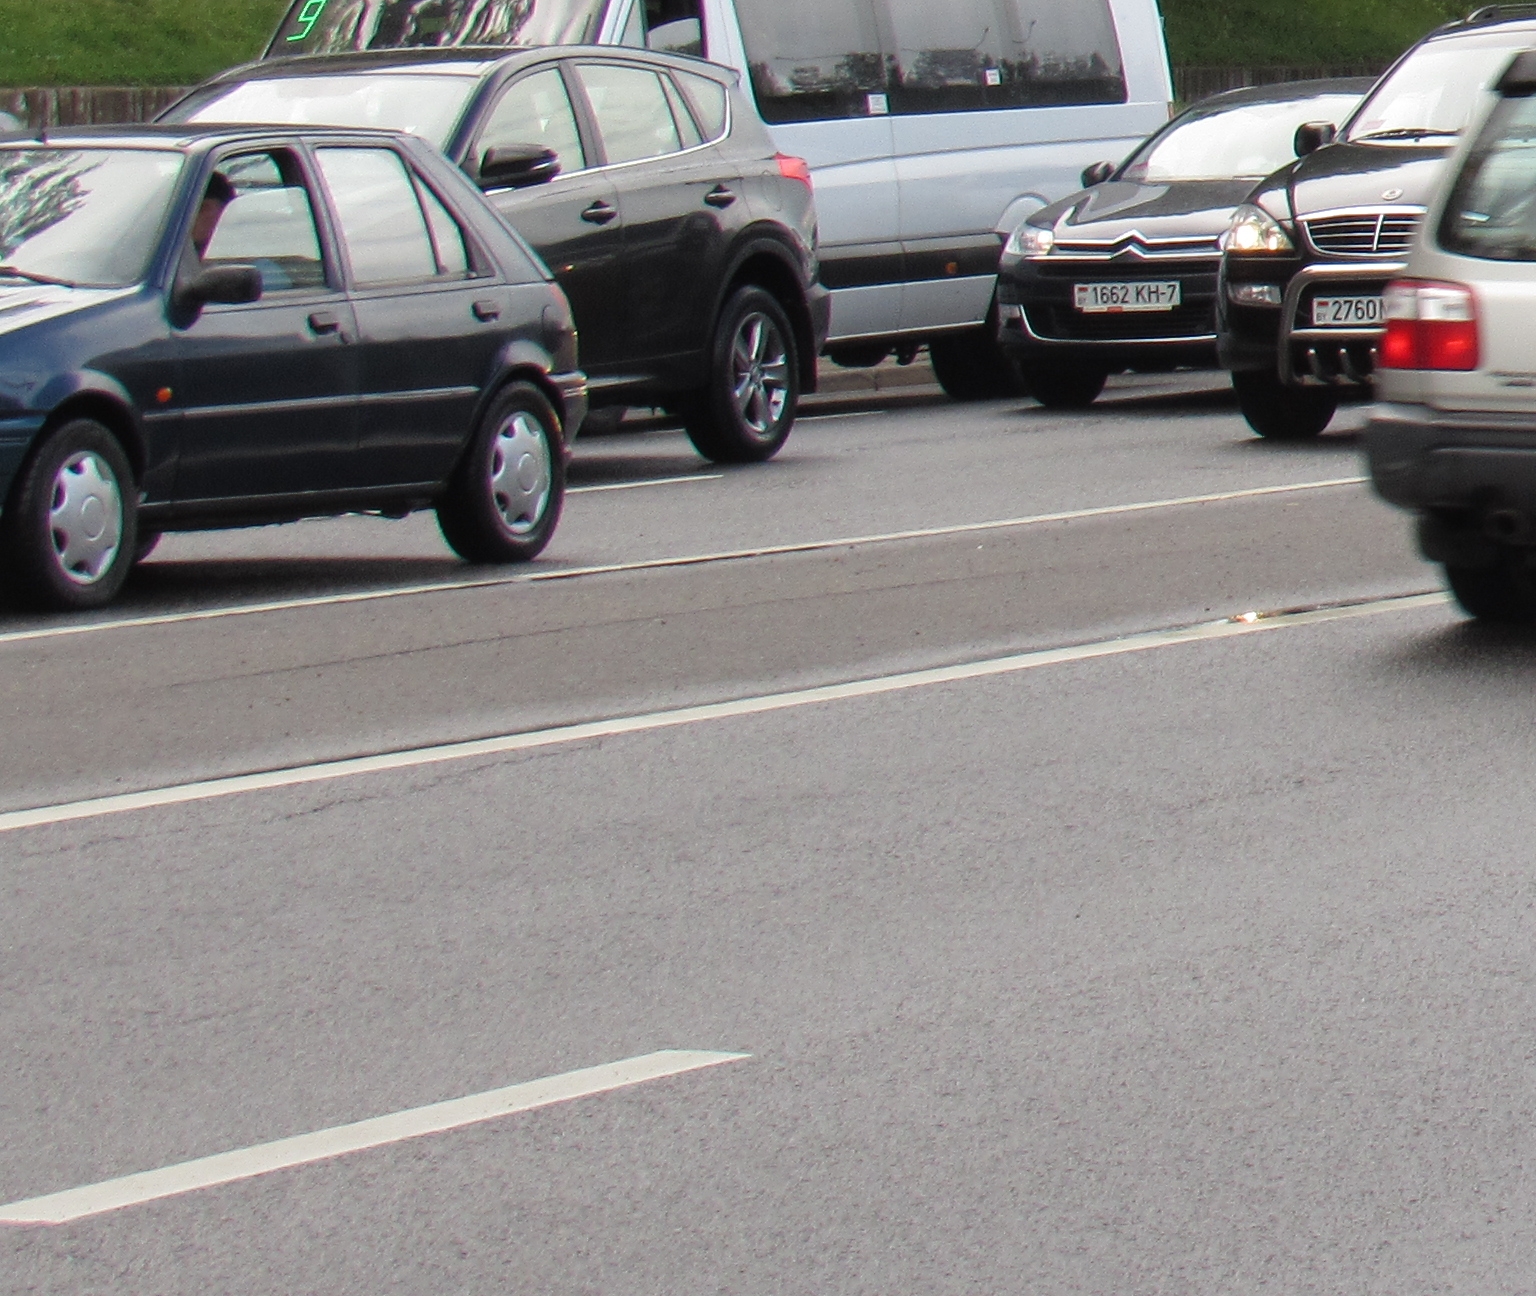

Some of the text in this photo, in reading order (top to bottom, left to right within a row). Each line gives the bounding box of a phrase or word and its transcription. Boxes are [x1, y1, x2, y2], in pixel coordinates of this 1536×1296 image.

[1092, 285, 1130, 304] 1662
[1135, 284, 1177, 303] KH-7
[1332, 299, 1377, 320] 2760
